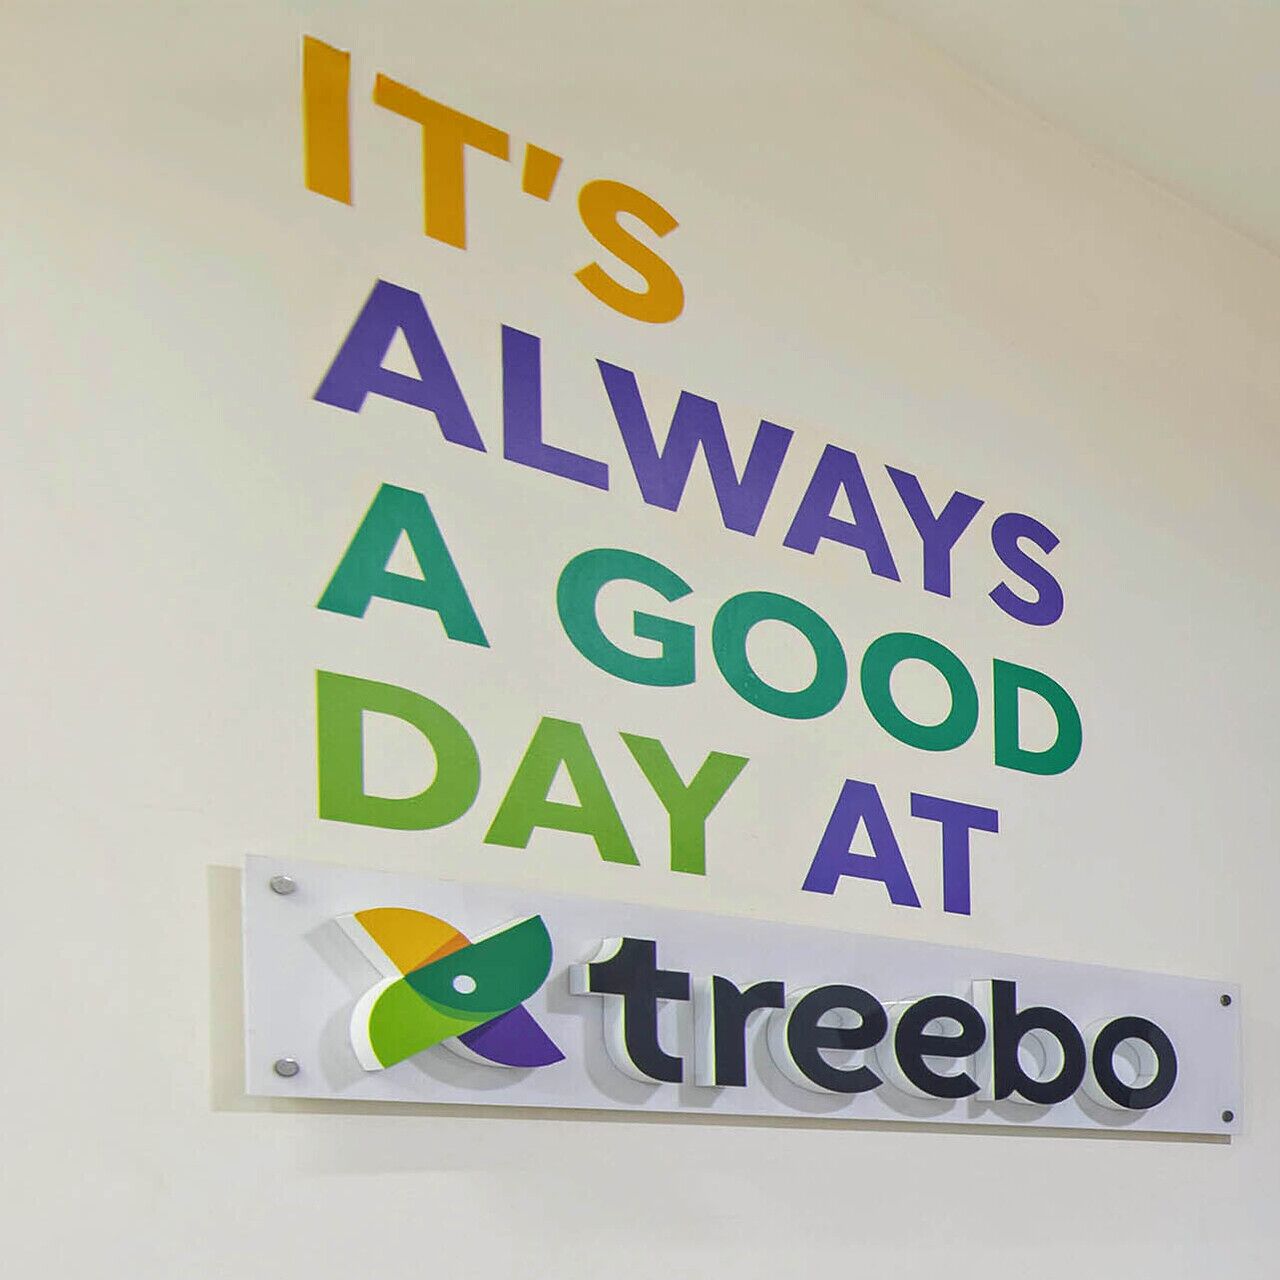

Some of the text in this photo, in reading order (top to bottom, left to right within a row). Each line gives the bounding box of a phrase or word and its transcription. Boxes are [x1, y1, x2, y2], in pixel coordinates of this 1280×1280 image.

[301, 36, 685, 324] IT'S
[313, 279, 1066, 627] ALWAYS
[317, 483, 1083, 776] A GOOD
[316, 669, 999, 916] DAY AT
[585, 936, 1178, 1111] treebo
